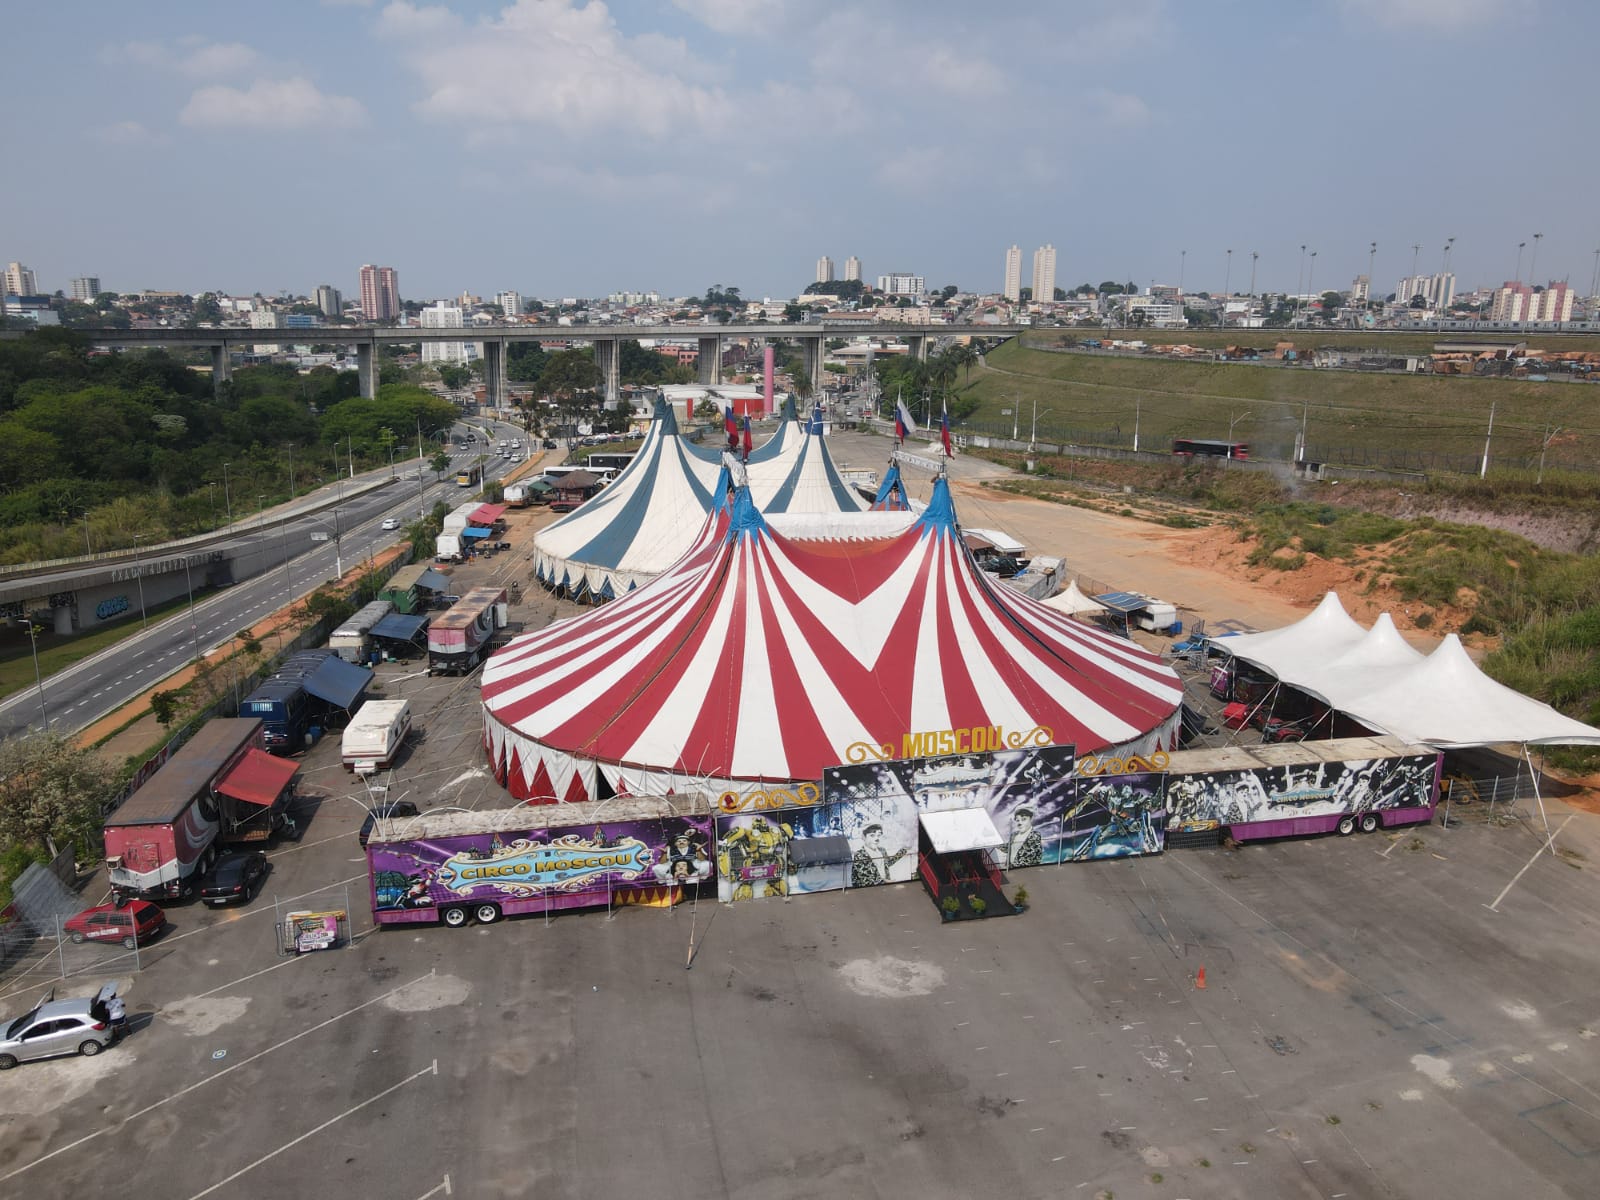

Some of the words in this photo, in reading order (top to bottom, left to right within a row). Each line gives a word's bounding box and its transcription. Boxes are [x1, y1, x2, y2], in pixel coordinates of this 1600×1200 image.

[902, 725, 1002, 759] MOSCOU
[461, 863, 531, 879] CIRCO
[535, 854, 632, 873] MOSCOU
